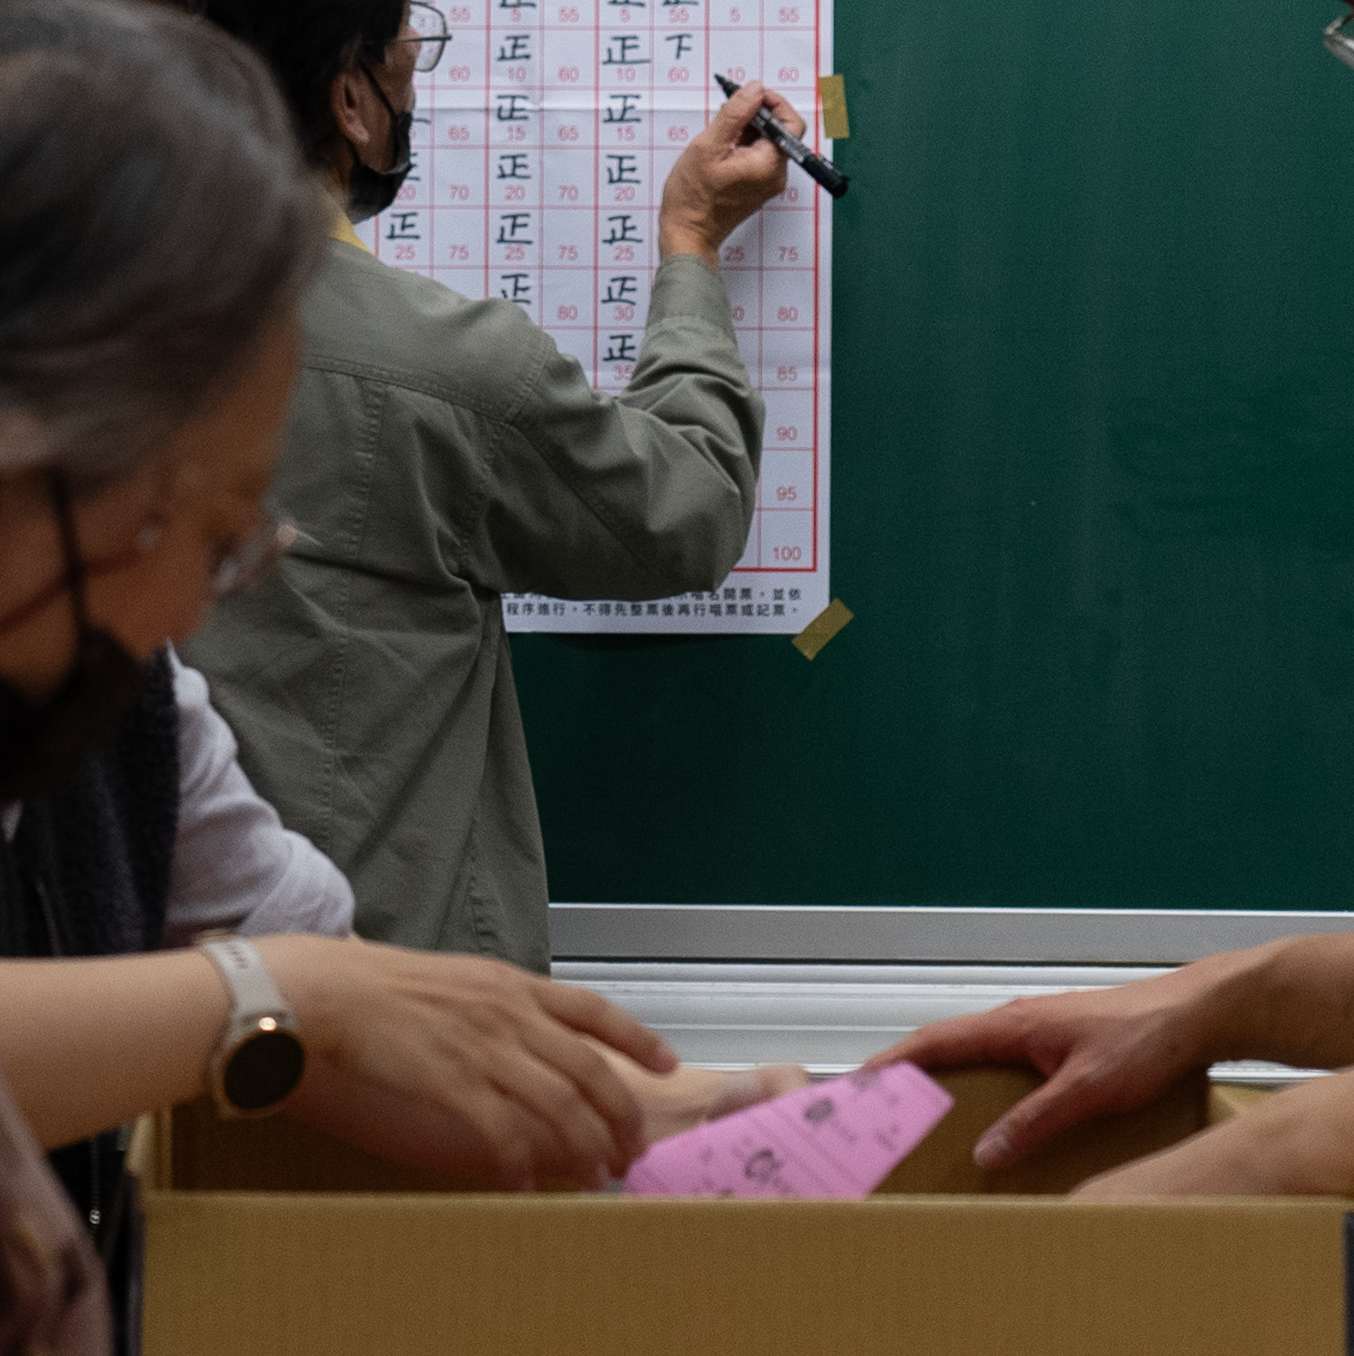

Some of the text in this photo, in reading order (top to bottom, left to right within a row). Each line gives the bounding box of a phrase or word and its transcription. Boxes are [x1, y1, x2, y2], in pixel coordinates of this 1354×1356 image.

[450, 6, 471, 23] 55
[558, 6, 580, 23] 55
[729, 6, 741, 23] 5
[778, 6, 800, 23] 55
[497, 34, 531, 62] 正
[603, 35, 651, 64] 正
[449, 66, 471, 83] 60
[508, 66, 527, 83] 10
[558, 66, 579, 83] 60
[617, 66, 636, 83] 10
[667, 66, 690, 83] 60
[778, 66, 800, 83] 60
[496, 94, 642, 124] 正 正
[507, 125, 526, 142] 15
[616, 125, 636, 142] 15
[497, 153, 642, 185] 正 正
[449, 184, 471, 201] 70
[504, 185, 526, 202] 20
[558, 185, 579, 202] 70
[614, 185, 635, 202] 20
[386, 212, 644, 245] 正 正 正
[396, 245, 416, 262] 25
[449, 245, 470, 262] 75
[504, 245, 525, 262] 25
[558, 245, 579, 262] 75
[613, 245, 634, 262] 25
[779, 245, 799, 262] 75
[601, 275, 638, 306] 正
[613, 306, 635, 323] 30
[602, 334, 637, 362] 正
[776, 425, 798, 442] 90
[775, 485, 798, 502] 95
[772, 545, 802, 562] 100
